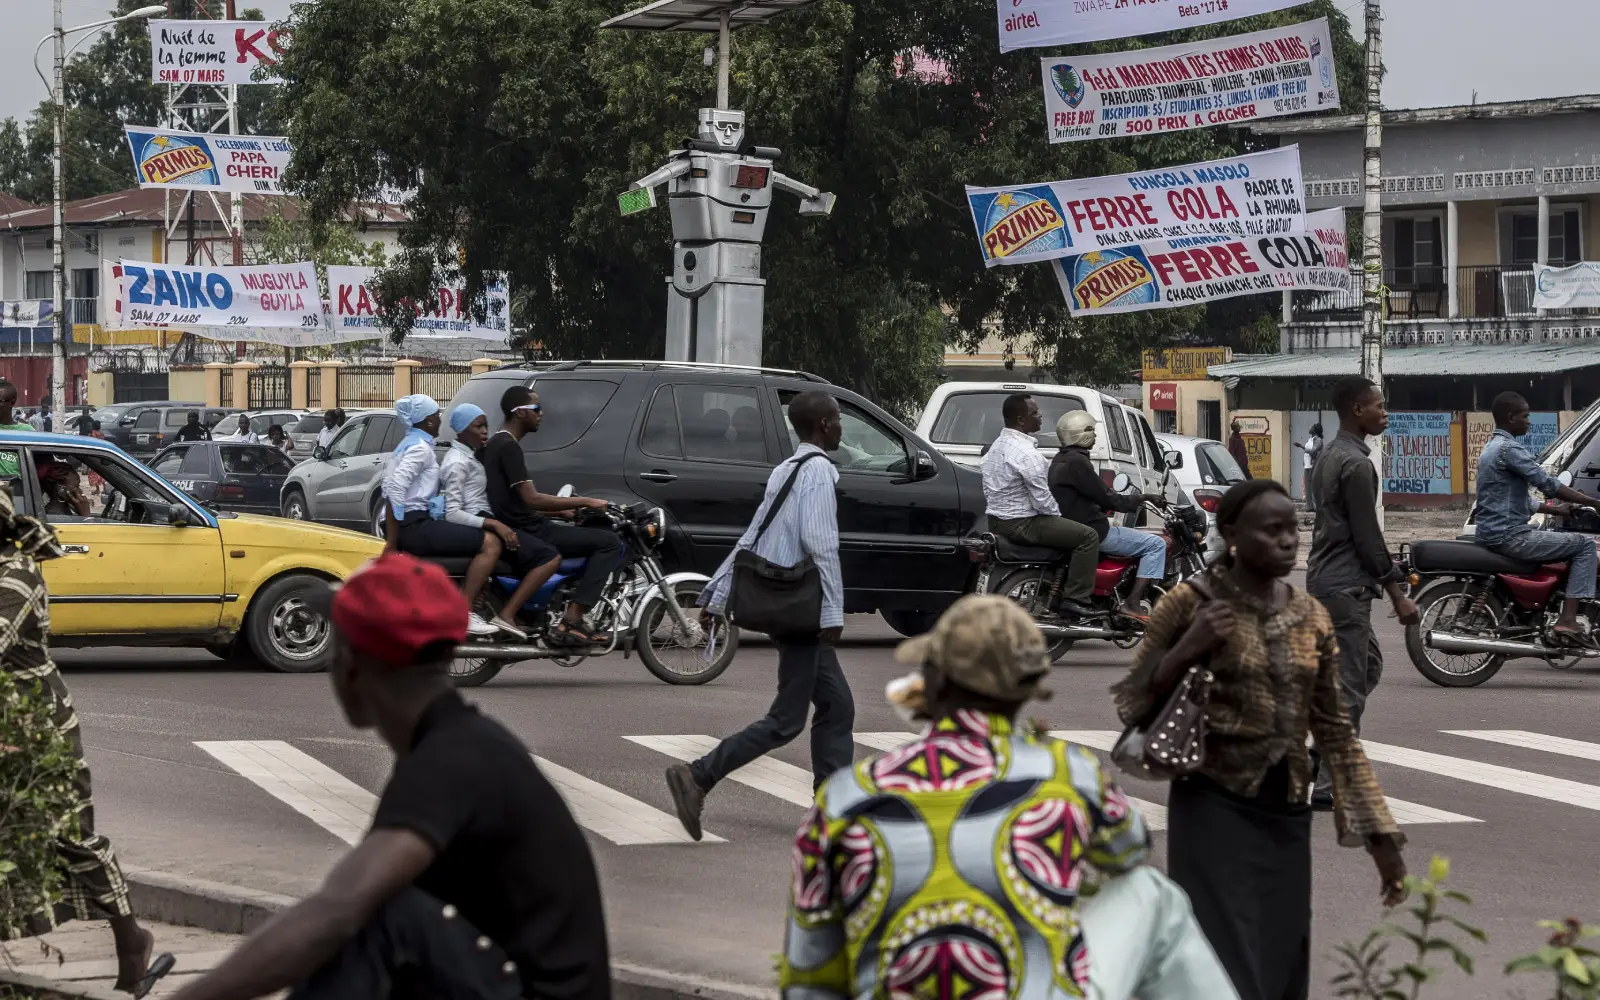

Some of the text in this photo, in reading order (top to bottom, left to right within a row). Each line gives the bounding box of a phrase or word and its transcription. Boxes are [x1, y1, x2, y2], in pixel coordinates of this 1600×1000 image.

[1178, 4, 1200, 17] Beta
[1005, 11, 1040, 31] airtel
[161, 28, 215, 45] Nuit de
[159, 48, 226, 67] la femme
[1116, 56, 1192, 89] MARATHON
[1186, 53, 1218, 78] DES
[1211, 45, 1264, 74] FEMMES
[1259, 41, 1281, 65] 08
[1274, 36, 1309, 61] MARS
[159, 69, 225, 82] SAM. 07 MARS
[1100, 88, 1157, 106] PARCOURS:
[1156, 81, 1207, 101] TRIOMPHAL
[1210, 74, 1246, 93] HUILERIE
[1102, 105, 1151, 121] INSCRIPTION:
[1152, 103, 1163, 116] 5$
[1170, 96, 1212, 115] ETUDIANTES
[1227, 88, 1253, 105] LUKUSA
[1258, 84, 1280, 101] GOMBE
[1281, 81, 1296, 96] FREE
[1296, 79, 1307, 94] BOX
[1054, 110, 1095, 127] FREE BOX
[1098, 103, 1258, 135] 08H 500 PRIX A GAGNER
[215, 140, 262, 151] CELEBRONS
[144, 149, 208, 183] PRIMUS
[230, 152, 268, 164] PAPA
[226, 164, 278, 179] CHERI
[1128, 163, 1250, 190] FUNGOLA MASOLO
[253, 180, 273, 191] DIM.
[1244, 178, 1295, 198] PADRE DE
[1067, 185, 1240, 233] FERRE GOLA
[1246, 198, 1302, 216] LA RHUMBA
[986, 202, 1057, 258] PRIMUS
[1133, 227, 1163, 241] MARS
[1163, 225, 1188, 237] CHEZ
[1265, 217, 1292, 235] GRATUIT
[1147, 242, 1260, 286] FERRE
[124, 265, 233, 310] ZAIKO
[240, 271, 308, 291] MUGUYLA
[1077, 260, 1147, 309] PRIMUS
[1166, 284, 1206, 302] CHAQUE
[1207, 276, 1253, 296] DIMANCHE
[1254, 273, 1275, 289] CHEZ
[260, 293, 305, 311] GUYLA
[156, 312, 170, 322] 07
[171, 314, 201, 324] MARS
[227, 315, 249, 325] 20H
[301, 312, 319, 327] 20$
[1171, 352, 1195, 369] DEBOUT
[1161, 391, 1174, 400] airtel
[1397, 435, 1451, 457] EVANGELIQUE
[1396, 457, 1451, 479] GLORIEUSE
[1387, 479, 1431, 493] CHRIST
